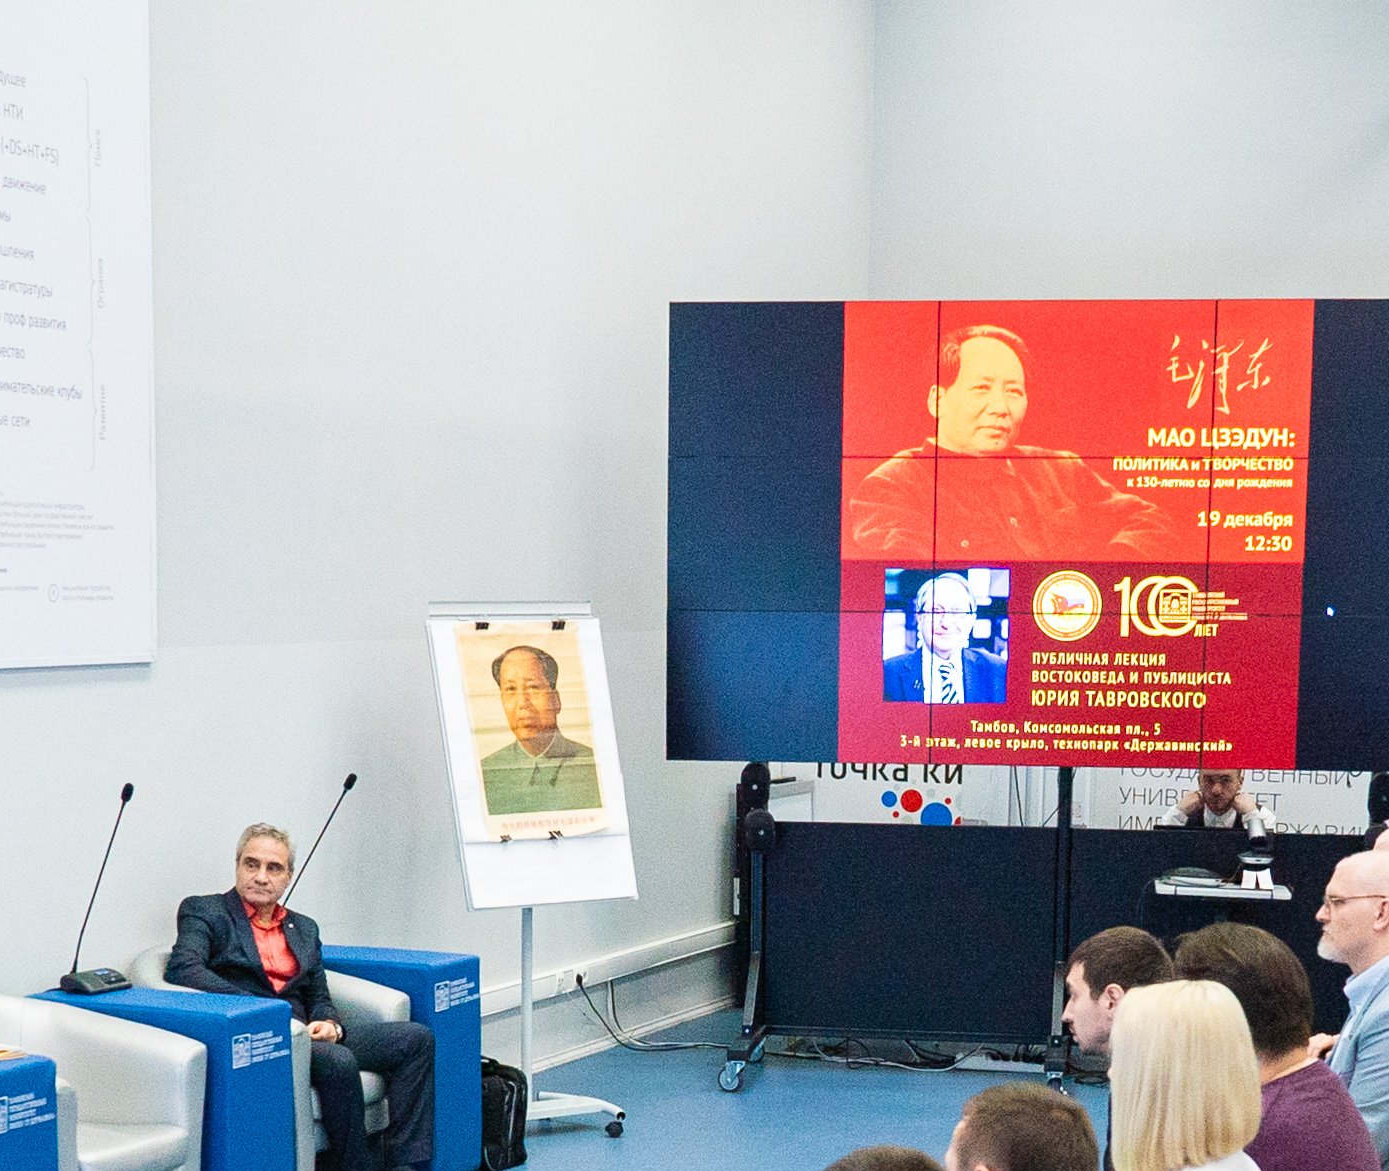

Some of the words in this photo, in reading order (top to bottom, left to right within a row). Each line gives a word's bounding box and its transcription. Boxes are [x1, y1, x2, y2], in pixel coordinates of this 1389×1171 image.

[1147, 427, 1196, 448] МАО
[1200, 427, 1296, 450] ЦЗЭДУН:
[1113, 457, 1189, 472] ПОЛИТИКА
[1191, 460, 1200, 471] и
[1202, 457, 1294, 472] ТВОРЧЕСТВО
[1126, 479, 1134, 488] к
[1136, 476, 1196, 489] 130-летию
[1197, 479, 1211, 488] со
[1213, 479, 1235, 490] дня
[1236, 478, 1294, 491] рождения
[1197, 511, 1221, 528] 19
[1224, 511, 1294, 531] декабря
[1244, 535, 1293, 552] 12:30
[1193, 624, 1219, 638] ЛЕТ
[1032, 651, 1109, 666] ПУБЛИЧНАЯ
[1113, 653, 1167, 667] ЛЕКЦИЯ
[1031, 670, 1126, 685] ВОСТОКОВЕДА
[1129, 671, 1139, 684] И
[1143, 671, 1232, 687] ПУБЛИЦИСТА
[1031, 689, 1080, 708] ЮРИЯ
[1085, 690, 1207, 710] ТАВРОВСКОГО
[970, 719, 1020, 735] Тамбов,
[1023, 721, 1121, 737] Комсомольская
[1153, 722, 1161, 737] 5
[900, 734, 921, 748] 3-й
[925, 737, 961, 750] этаж,
[963, 737, 1001, 749] левое
[1006, 737, 1049, 752] крыло,
[1053, 739, 1119, 753] технопарк
[1123, 738, 1234, 754] «Державинский»
